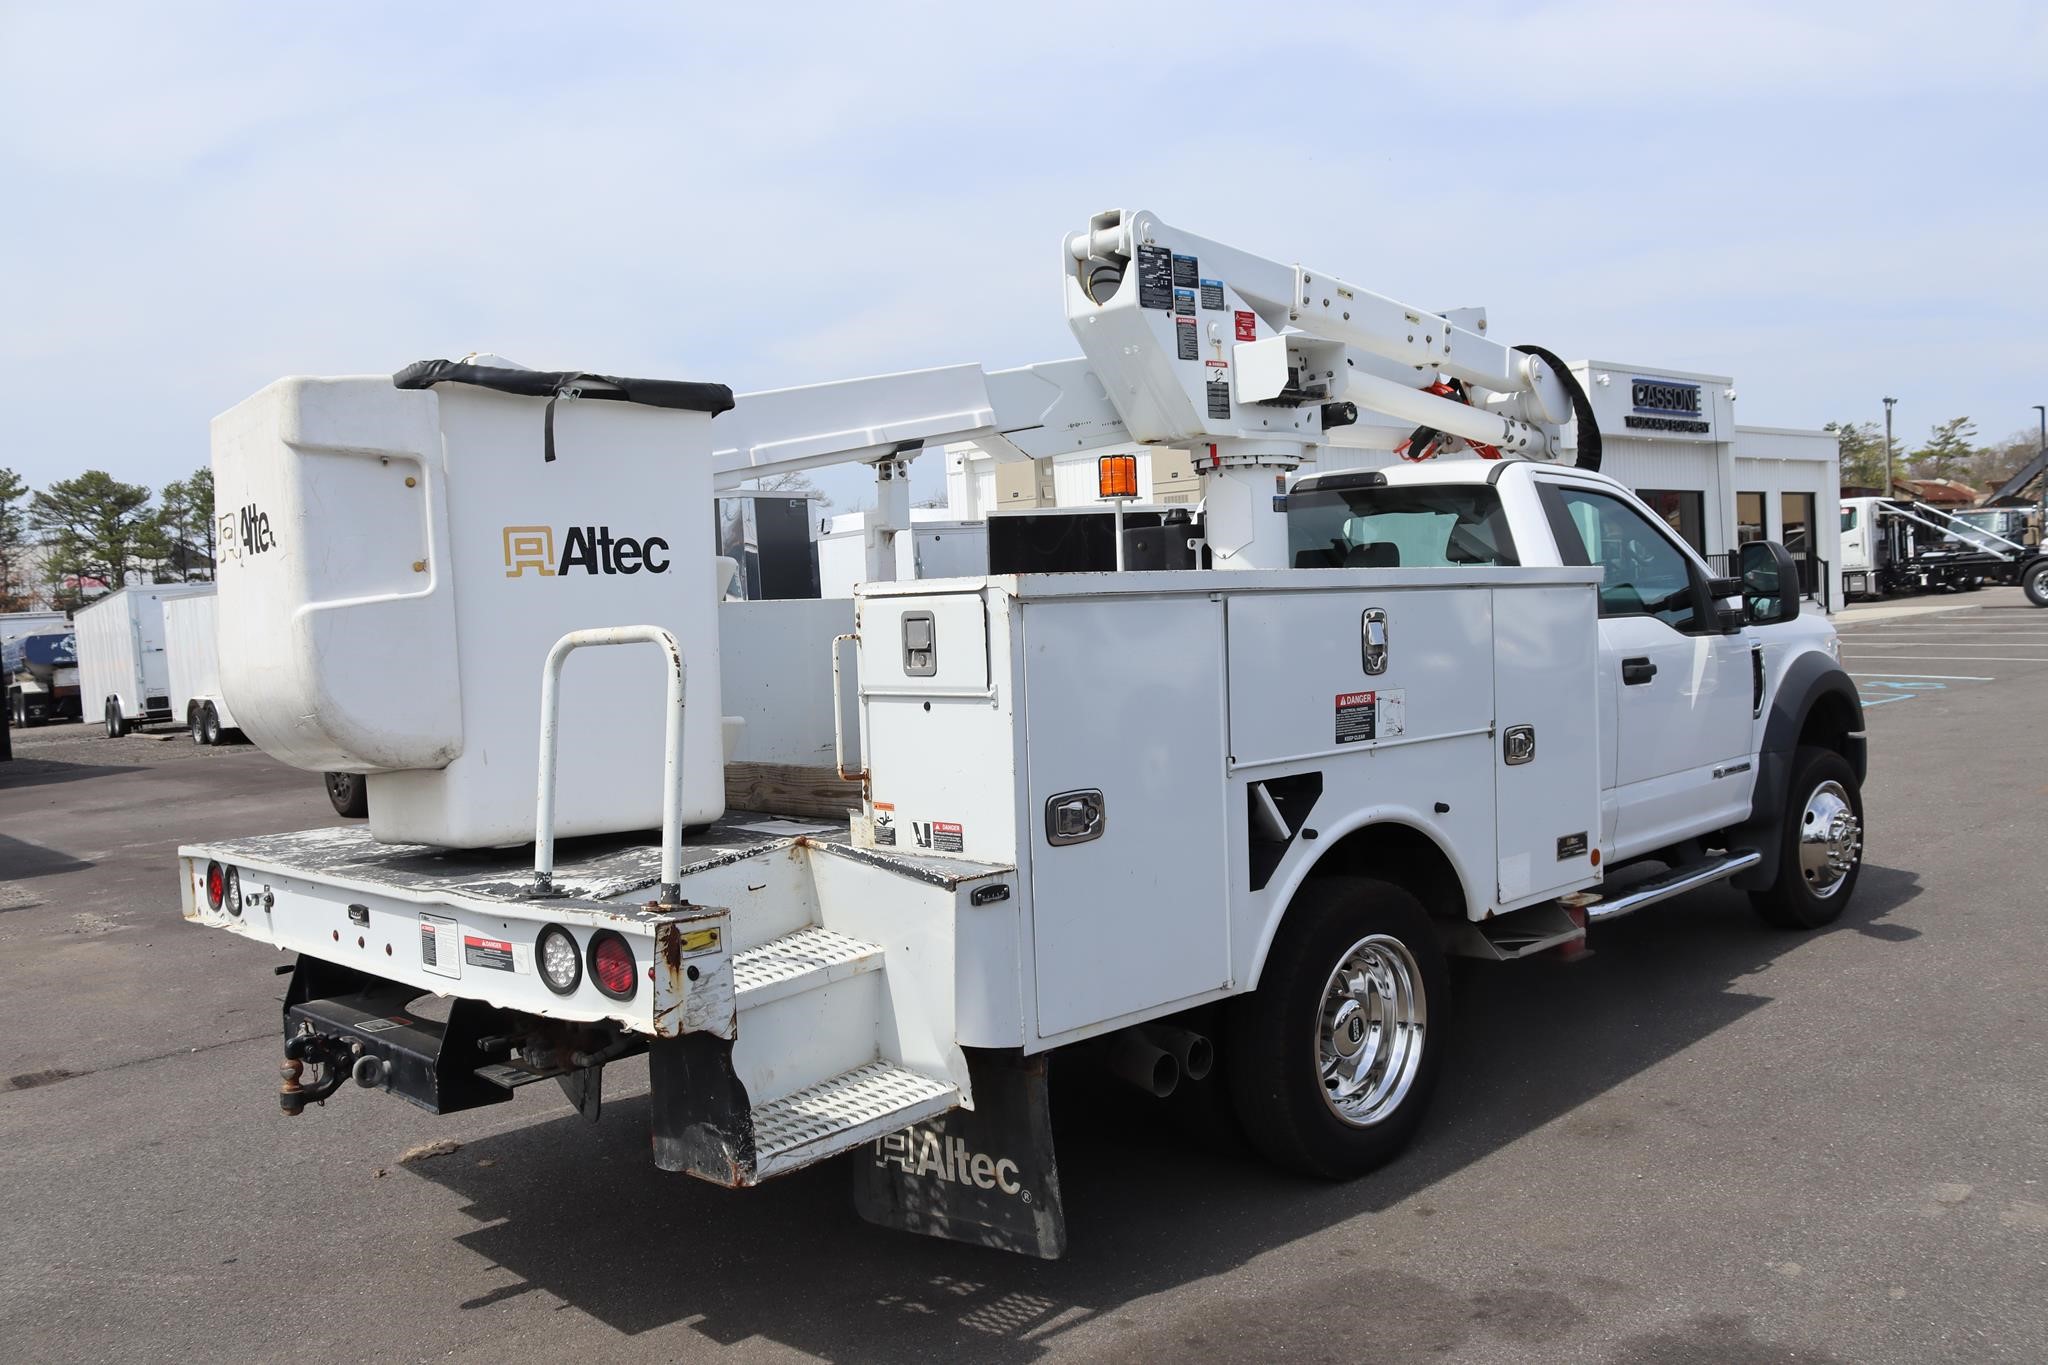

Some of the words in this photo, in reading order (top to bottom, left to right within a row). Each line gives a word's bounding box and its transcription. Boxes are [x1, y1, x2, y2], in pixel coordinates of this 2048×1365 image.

[1632, 383, 1702, 411] CASSONE
[1624, 416, 1653, 430] TRUCK
[241, 503, 276, 555] Alte
[558, 526, 671, 575] Altec
[1346, 694, 1372, 705] DANGER
[942, 823, 961, 831] DANGER
[917, 1130, 1021, 1195] Altec
